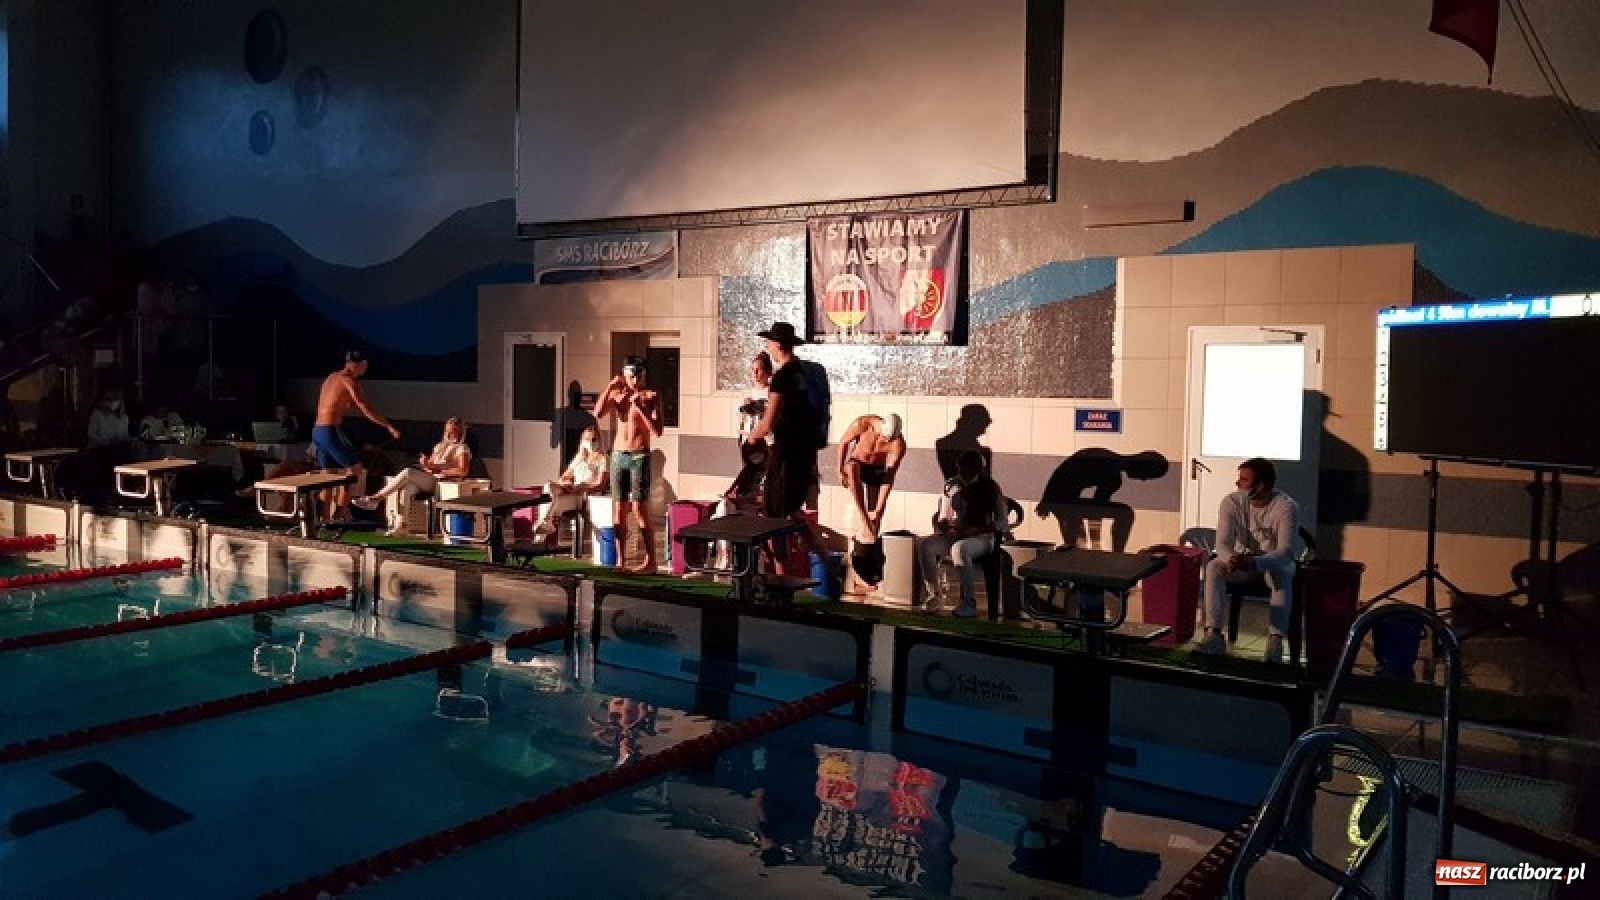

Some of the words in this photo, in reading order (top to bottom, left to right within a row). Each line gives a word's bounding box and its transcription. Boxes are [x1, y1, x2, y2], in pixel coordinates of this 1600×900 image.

[827, 217, 943, 241] STAWIAMY
[831, 249, 860, 265] NA
[864, 245, 937, 264] SPORT
